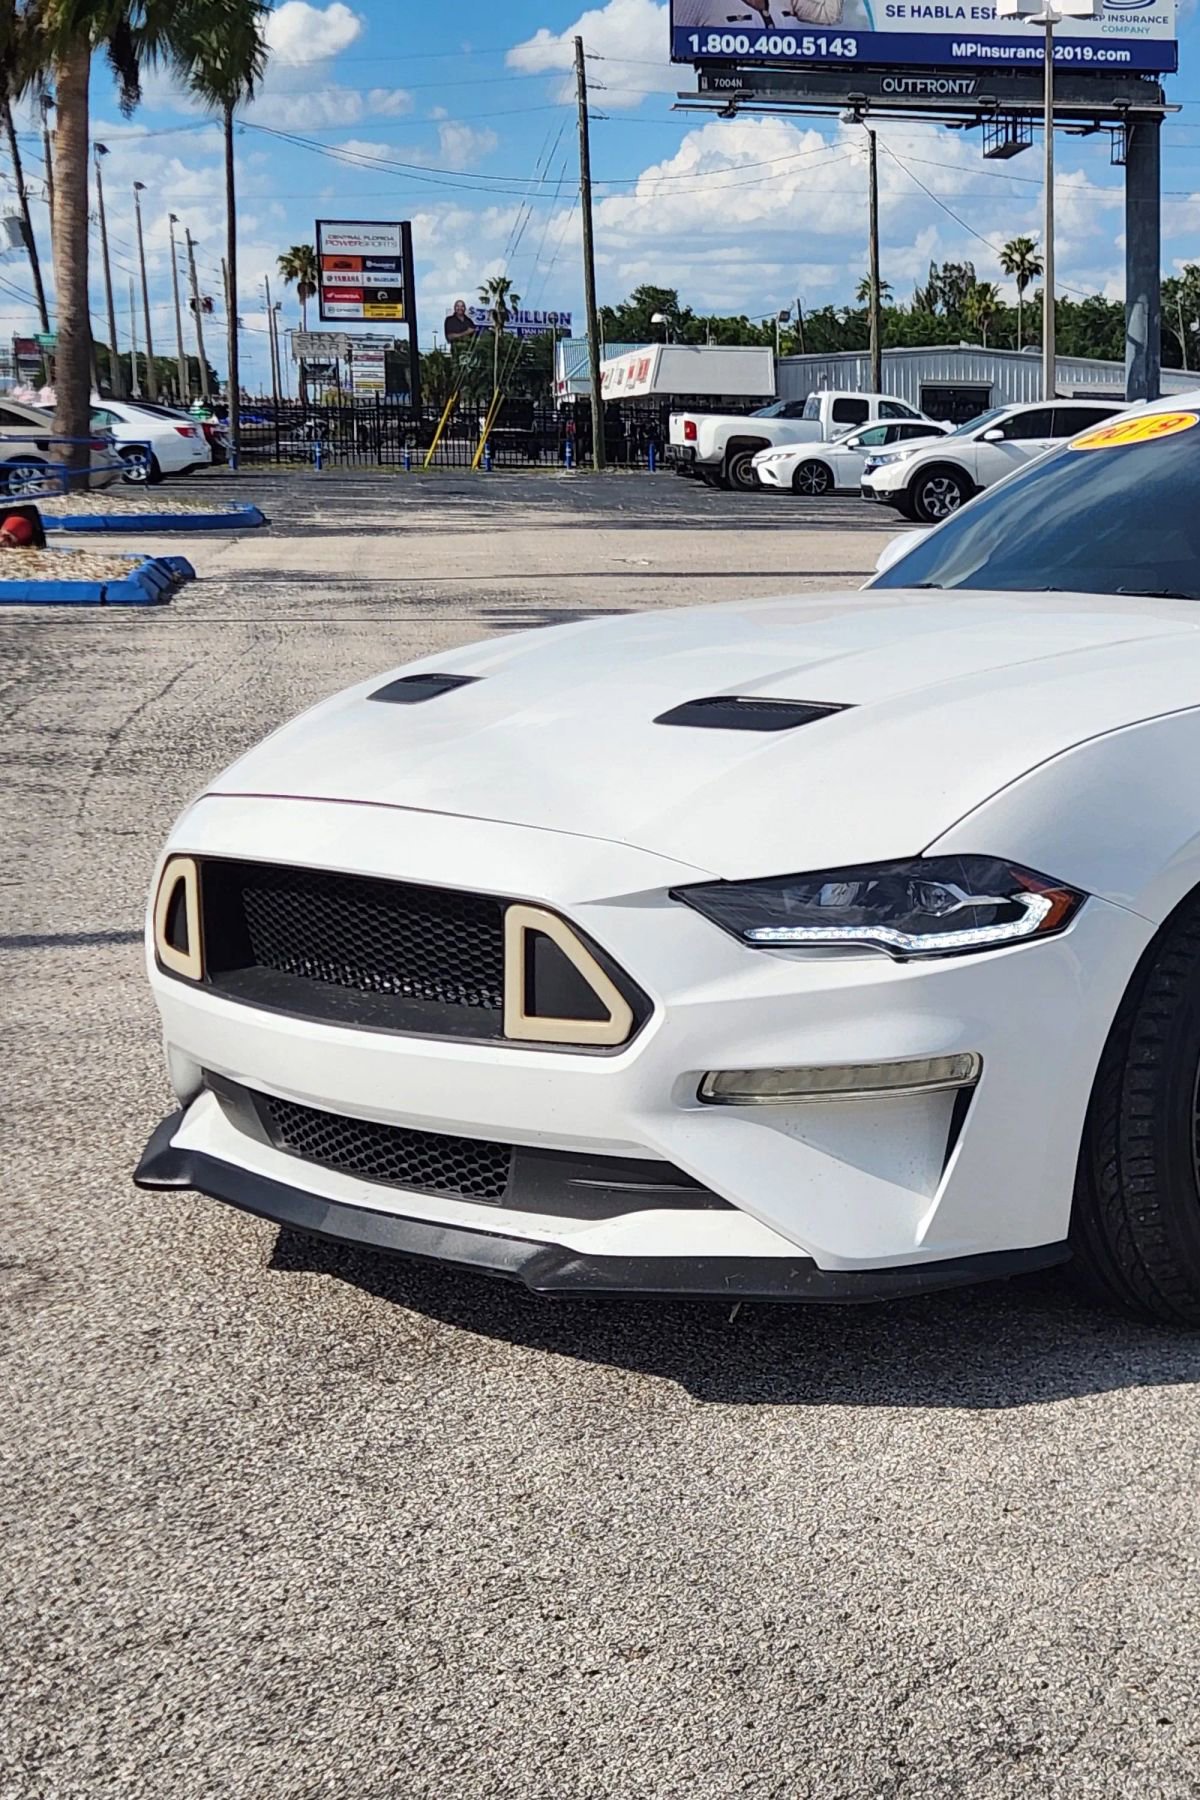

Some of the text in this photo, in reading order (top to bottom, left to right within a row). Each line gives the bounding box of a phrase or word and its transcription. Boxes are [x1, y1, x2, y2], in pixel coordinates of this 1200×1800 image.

[886, 4, 906, 18] SE
[910, 6, 966, 19] HABLA
[1108, 14, 1169, 25] INSURANCE
[1101, 25, 1151, 35] COMPANY
[688, 34, 858, 57] 1.800.400.5143
[952, 43, 1130, 62] MPInsuranc2019.com
[714, 78, 743, 88] 7004N
